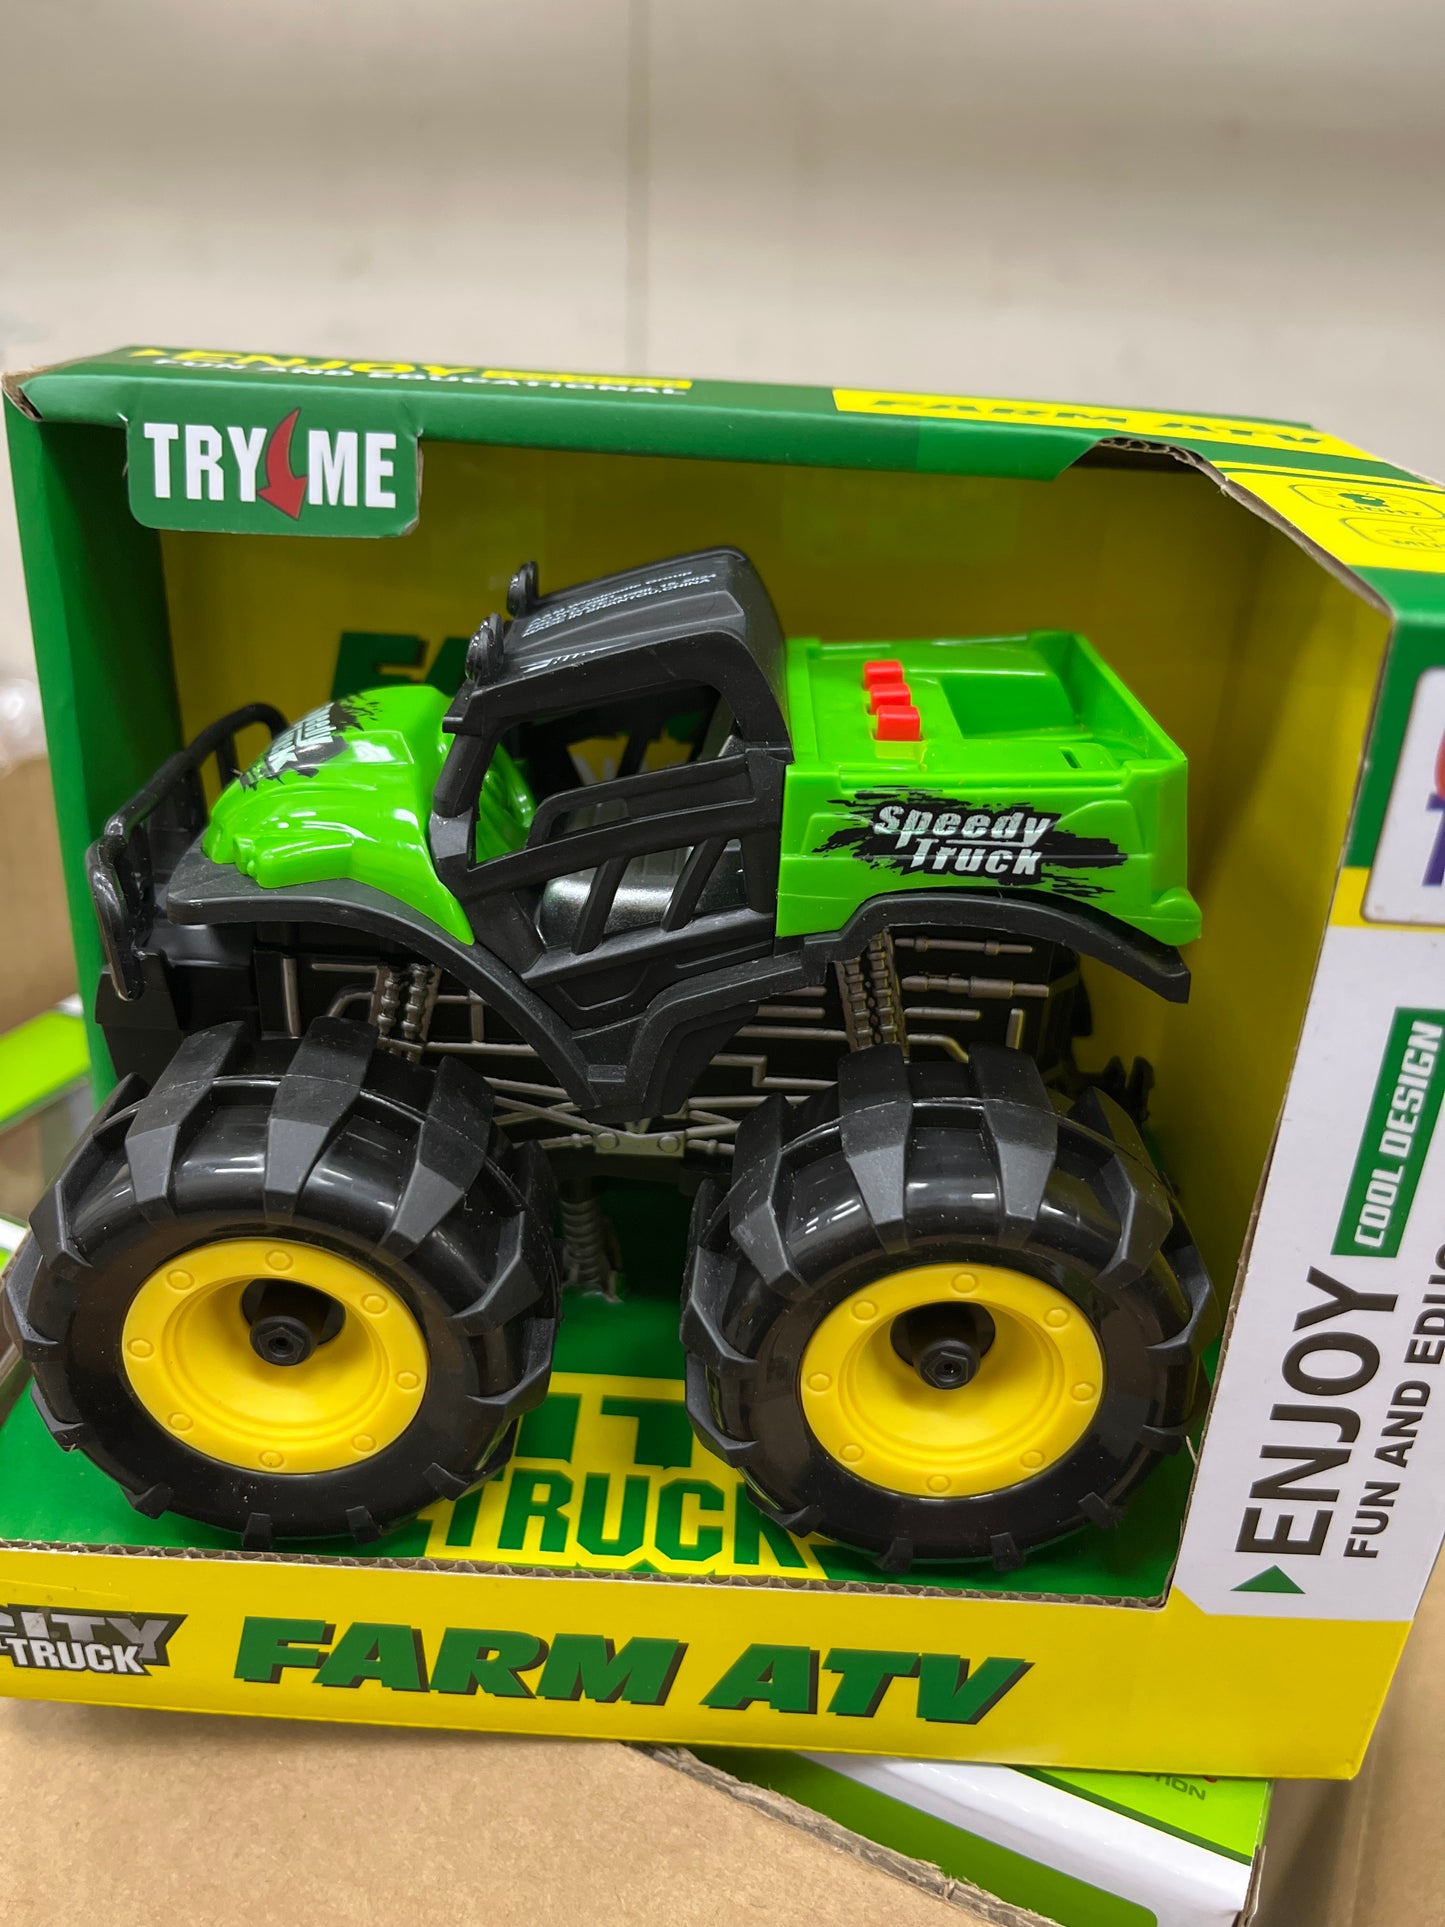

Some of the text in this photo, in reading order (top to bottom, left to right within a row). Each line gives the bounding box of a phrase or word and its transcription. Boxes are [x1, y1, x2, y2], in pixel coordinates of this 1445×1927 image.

[152, 358, 248, 370] FUN
[257, 366, 355, 377] AND
[367, 372, 687, 395] EDUCATIONAL
[172, 350, 476, 376] ENJOY
[871, 400, 1323, 444] FARM ATV
[144, 422, 396, 509] TRY ME
[873, 804, 1052, 850] Speedy
[909, 838, 1043, 876] Truck
[1354, 1020, 1443, 1248] COOL DESIGN
[1235, 1265, 1399, 1556] ENJOY
[1343, 1481, 1401, 1558] FUN
[1374, 1380, 1431, 1469] AND
[5, 1637, 145, 1674] TRUCK
[233, 1615, 1035, 1725] FARM ATV
